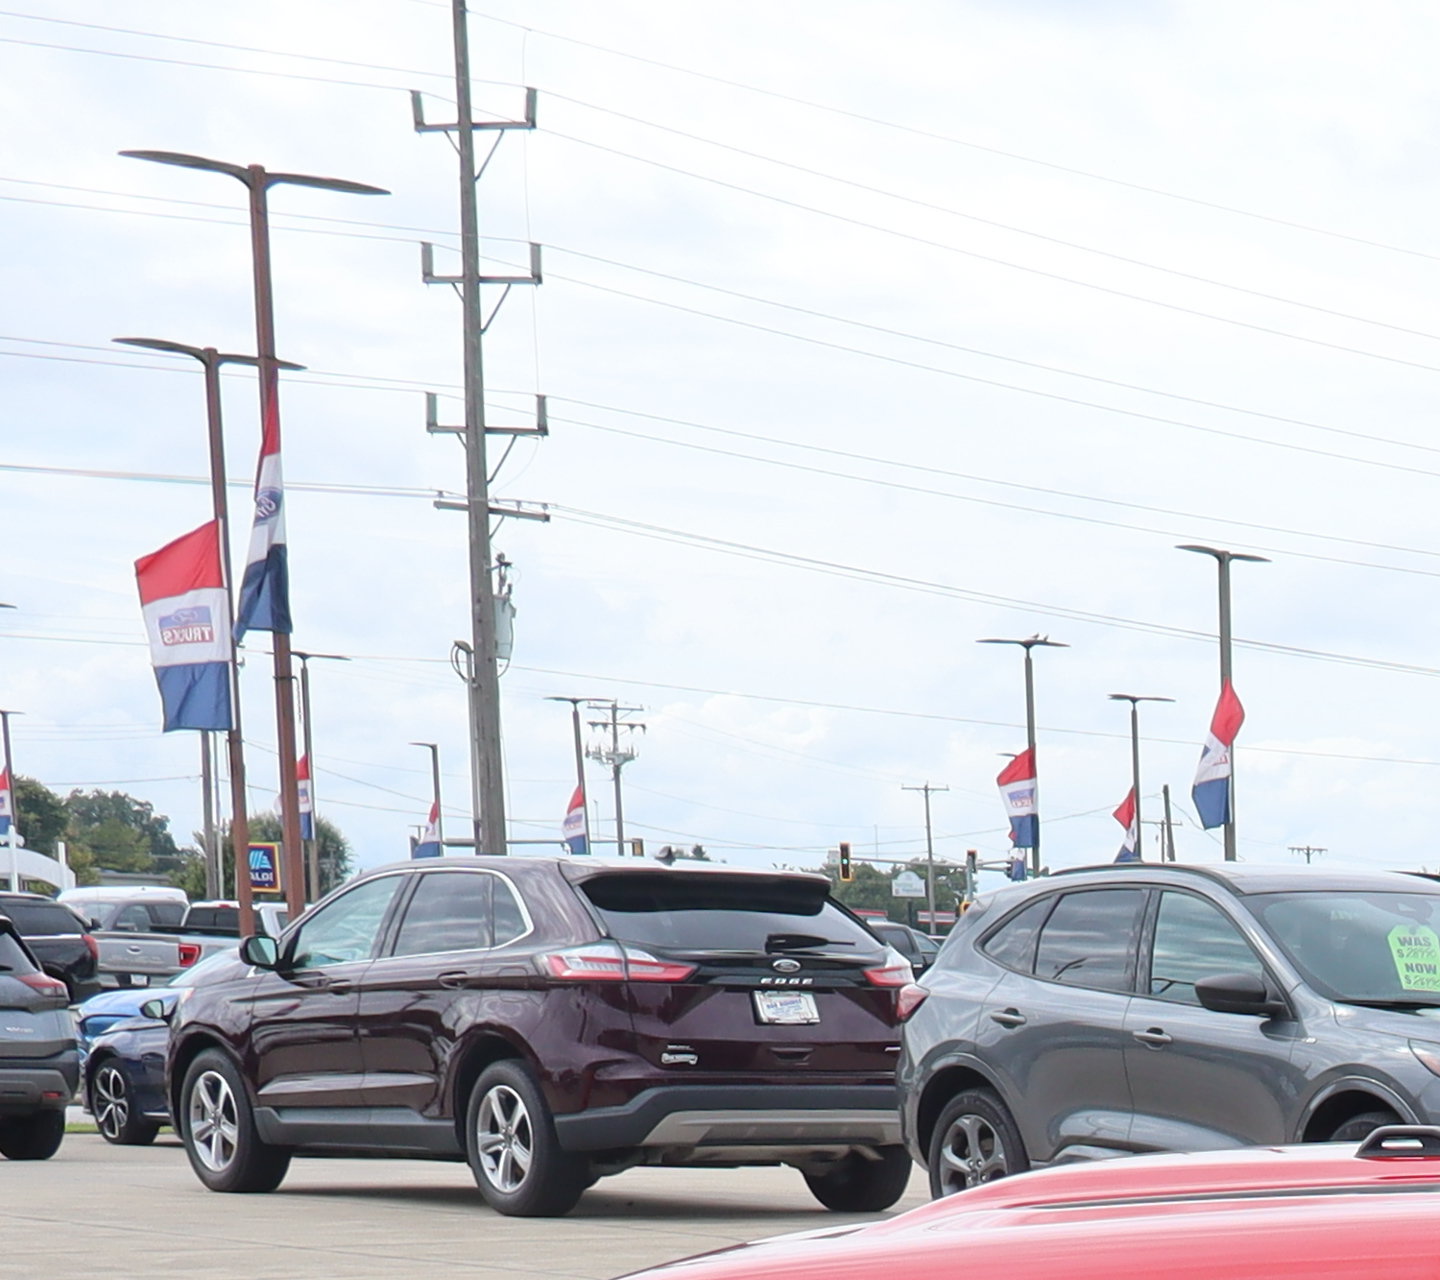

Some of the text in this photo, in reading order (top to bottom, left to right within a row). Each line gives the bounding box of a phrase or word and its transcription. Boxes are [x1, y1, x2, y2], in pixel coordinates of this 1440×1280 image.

[1397, 936, 1432, 947] WAS
[1404, 963, 1437, 974] NOW
[761, 977, 813, 985] EDGE
